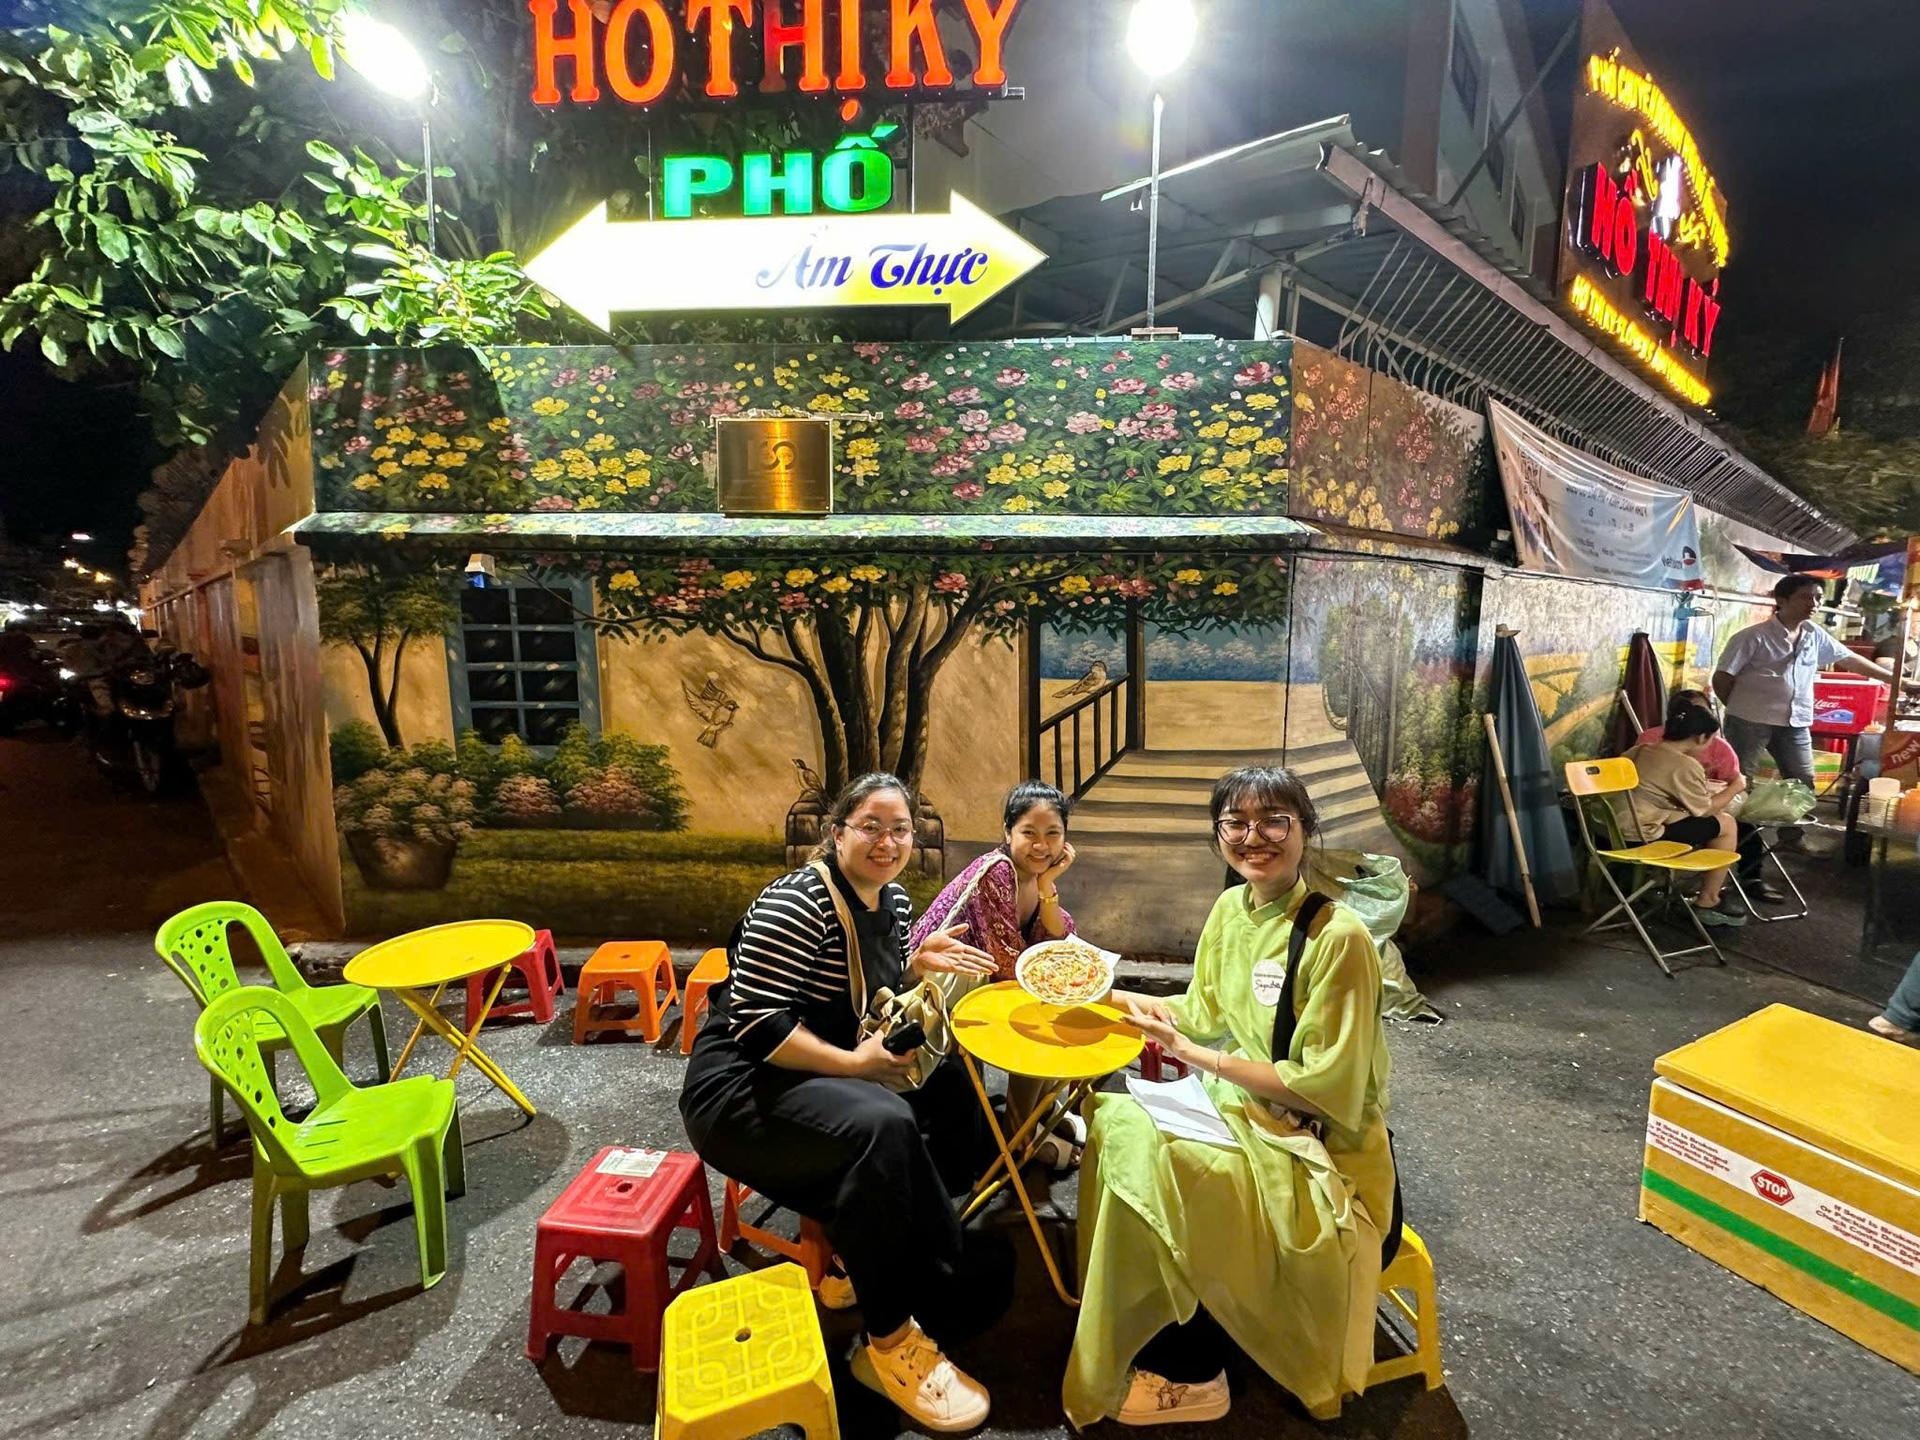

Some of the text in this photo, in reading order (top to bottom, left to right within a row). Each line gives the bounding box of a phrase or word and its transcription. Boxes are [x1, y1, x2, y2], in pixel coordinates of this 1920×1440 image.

[663, 123, 899, 219] PHỐ
[868, 242, 989, 296] Thực
[1891, 739, 1920, 764] new
[1757, 1176, 1788, 1198] STOP
[1815, 1209, 1847, 1228] Check
[1849, 1226, 1897, 1252] Contents
[1820, 1205, 1832, 1214] Or
[1834, 1212, 1879, 1236] Package
[1844, 1208, 1866, 1223] Seal
[1832, 1224, 1914, 1268] Signing Receipt
